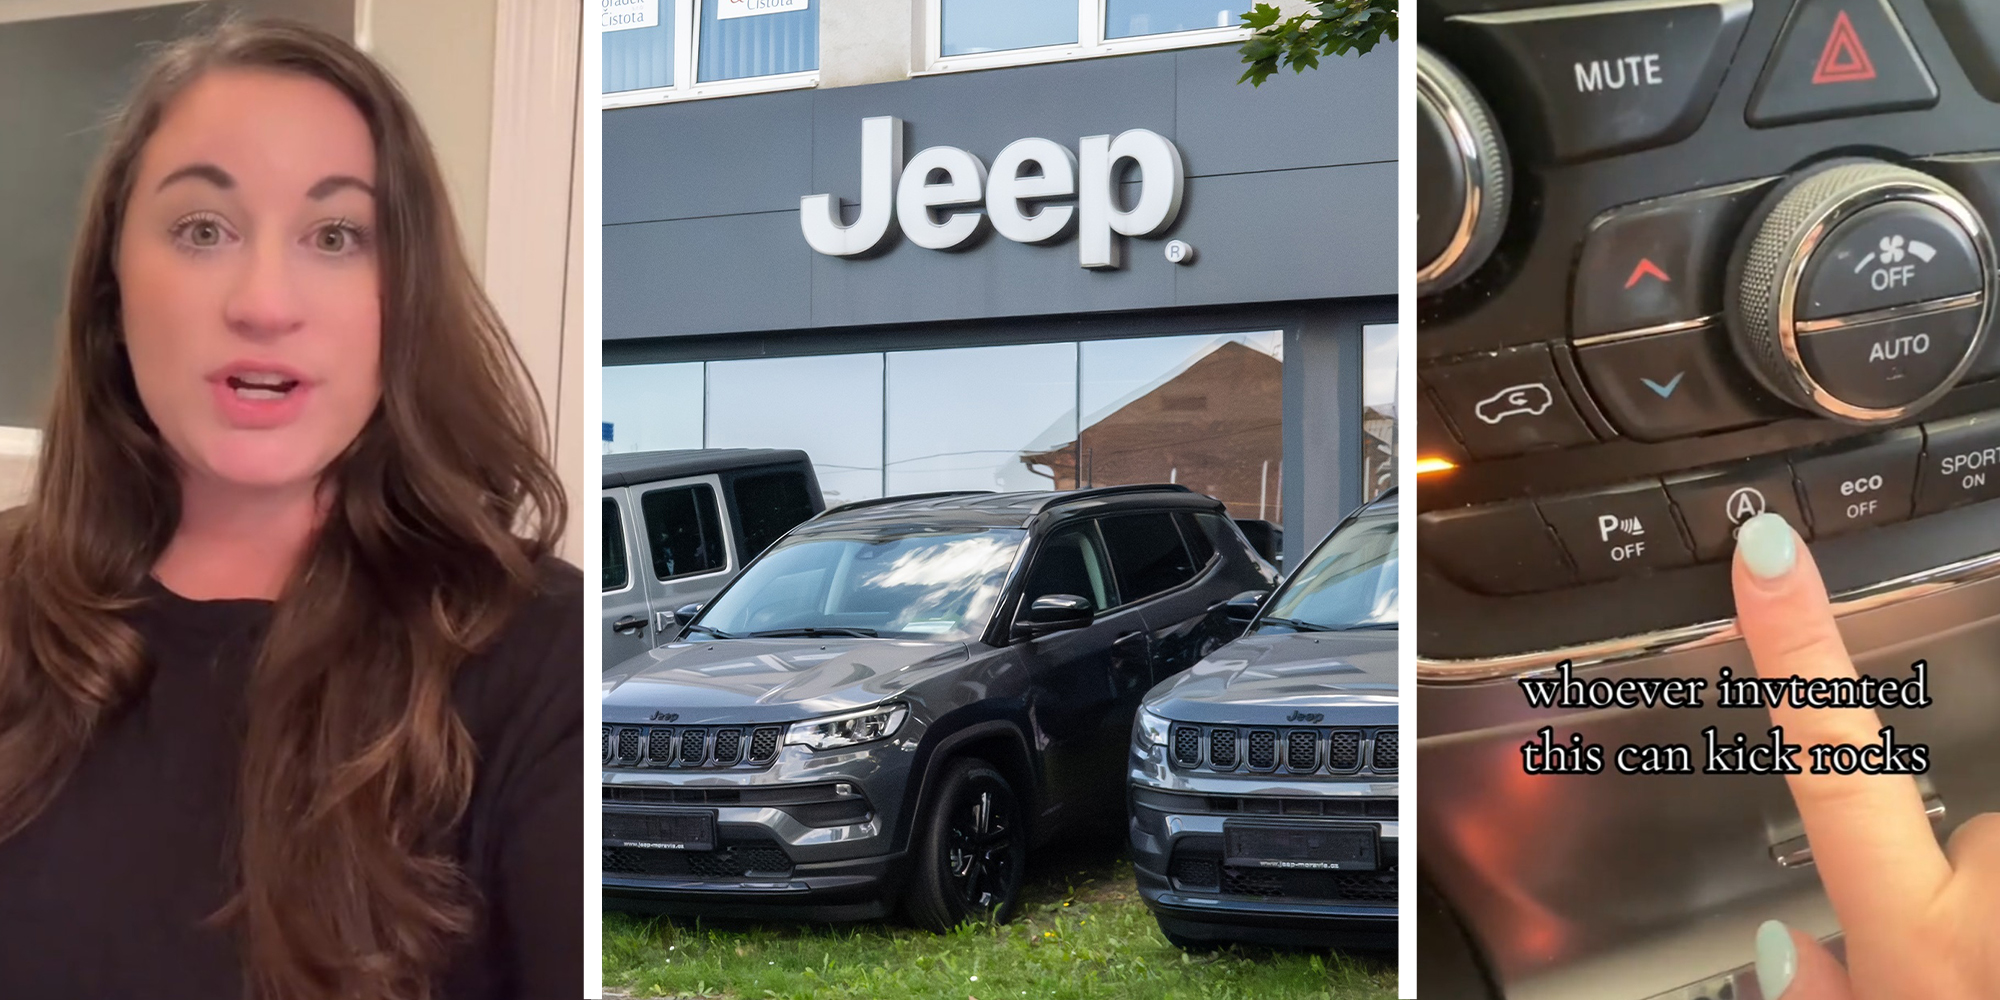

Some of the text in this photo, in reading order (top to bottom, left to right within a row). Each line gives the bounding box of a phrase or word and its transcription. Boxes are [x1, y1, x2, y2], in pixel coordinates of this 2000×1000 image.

[1574, 53, 1663, 92] MUTE
[800, 115, 1185, 268] Jeep
[1870, 264, 1915, 291] OFF
[1868, 333, 1930, 363] AUTO
[1840, 474, 1883, 497] eco
[1962, 472, 1986, 489] ON
[1846, 499, 1878, 519] OFF
[1598, 514, 1619, 542] P
[1611, 541, 1645, 562] OFF
[649, 710, 680, 723] Jeep
[1286, 710, 1325, 724] Jeep
